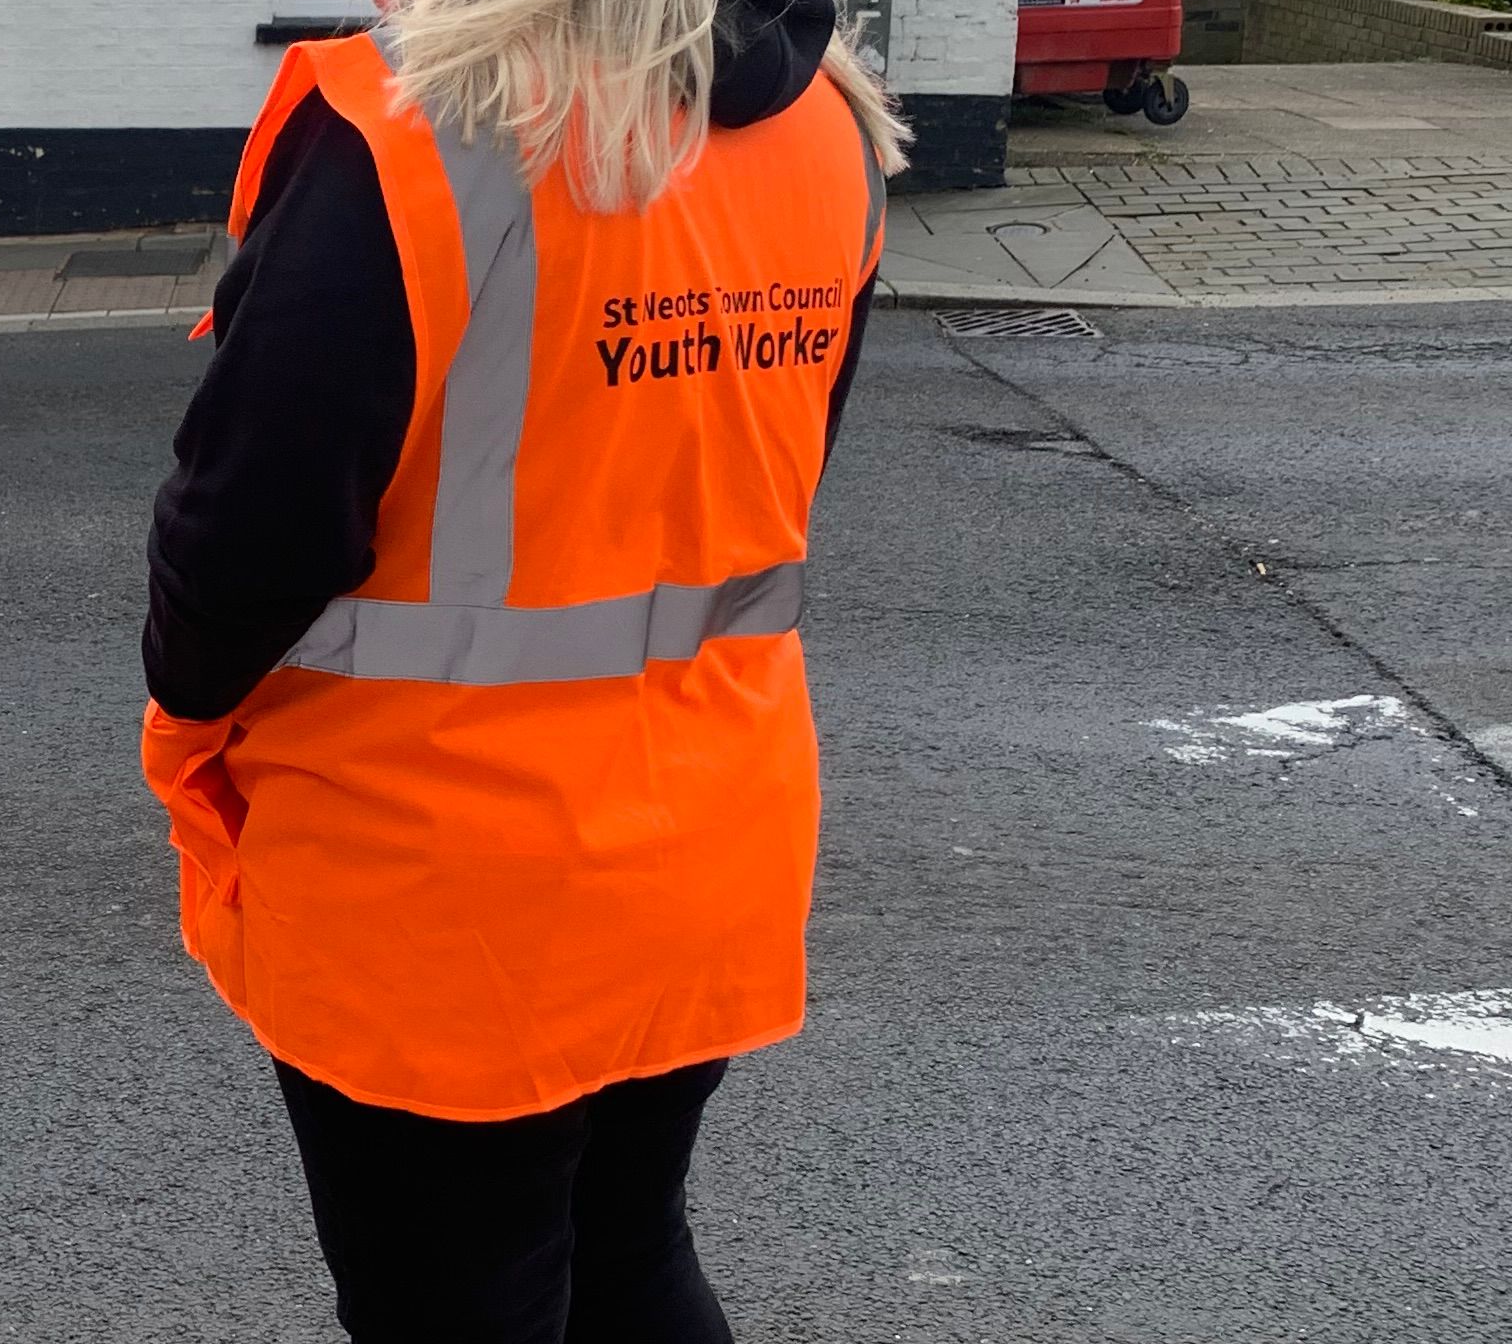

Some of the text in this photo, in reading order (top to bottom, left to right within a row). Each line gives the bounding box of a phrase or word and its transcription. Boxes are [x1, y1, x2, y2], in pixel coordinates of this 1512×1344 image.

[603, 278, 843, 328] St Neots own Council
[596, 321, 721, 387] Youth
